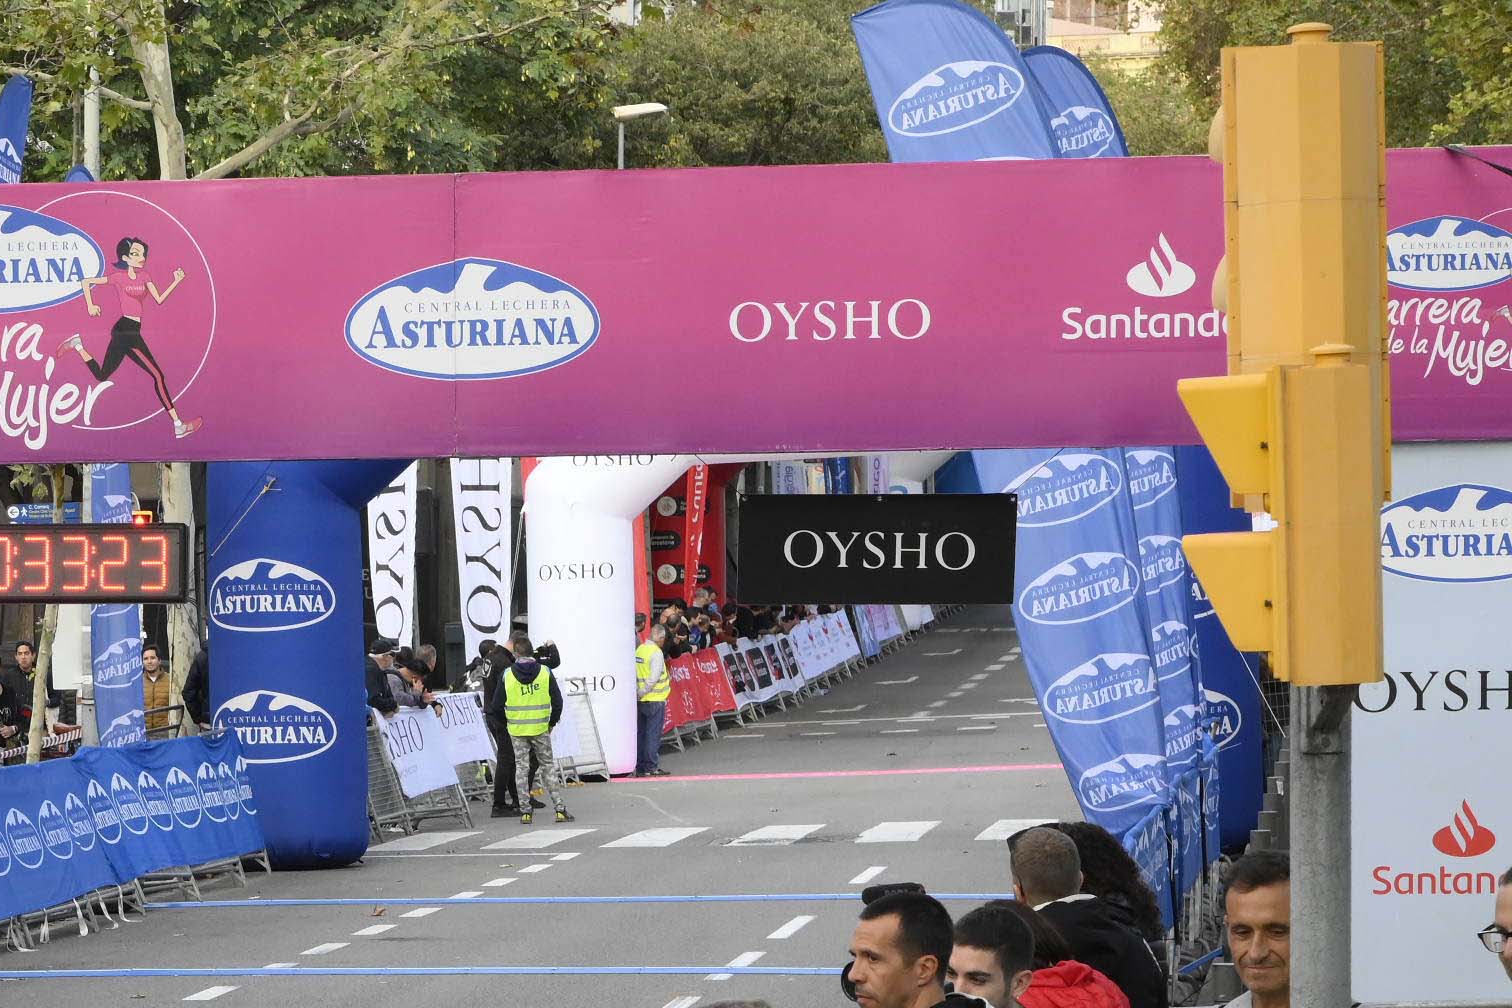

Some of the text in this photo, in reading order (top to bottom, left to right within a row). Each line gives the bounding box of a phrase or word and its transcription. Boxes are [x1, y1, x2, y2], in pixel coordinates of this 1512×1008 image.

[7, 240, 79, 252] LECHERA
[404, 299, 571, 313] CENTRAL LECHERA
[729, 298, 931, 343] OYSHO
[1387, 296, 1483, 326] arrera
[365, 305, 580, 349] ASTURIANA
[1061, 306, 1229, 340] Santand
[1410, 326, 1429, 354] la
[1424, 320, 1512, 386] Muje
[1407, 517, 1512, 529] CENTRAL LEC
[783, 529, 977, 571] OYSHO
[539, 562, 614, 582] OYSHO
[213, 587, 327, 616] ASTURIANA
[226, 583, 322, 593] CENTRAL LECHERA
[520, 683, 541, 697] Life
[568, 674, 617, 693] SHO
[1352, 668, 1512, 713] OYSH
[227, 715, 322, 724] CENTRAL LECHERA
[1372, 865, 1497, 895] Santan
